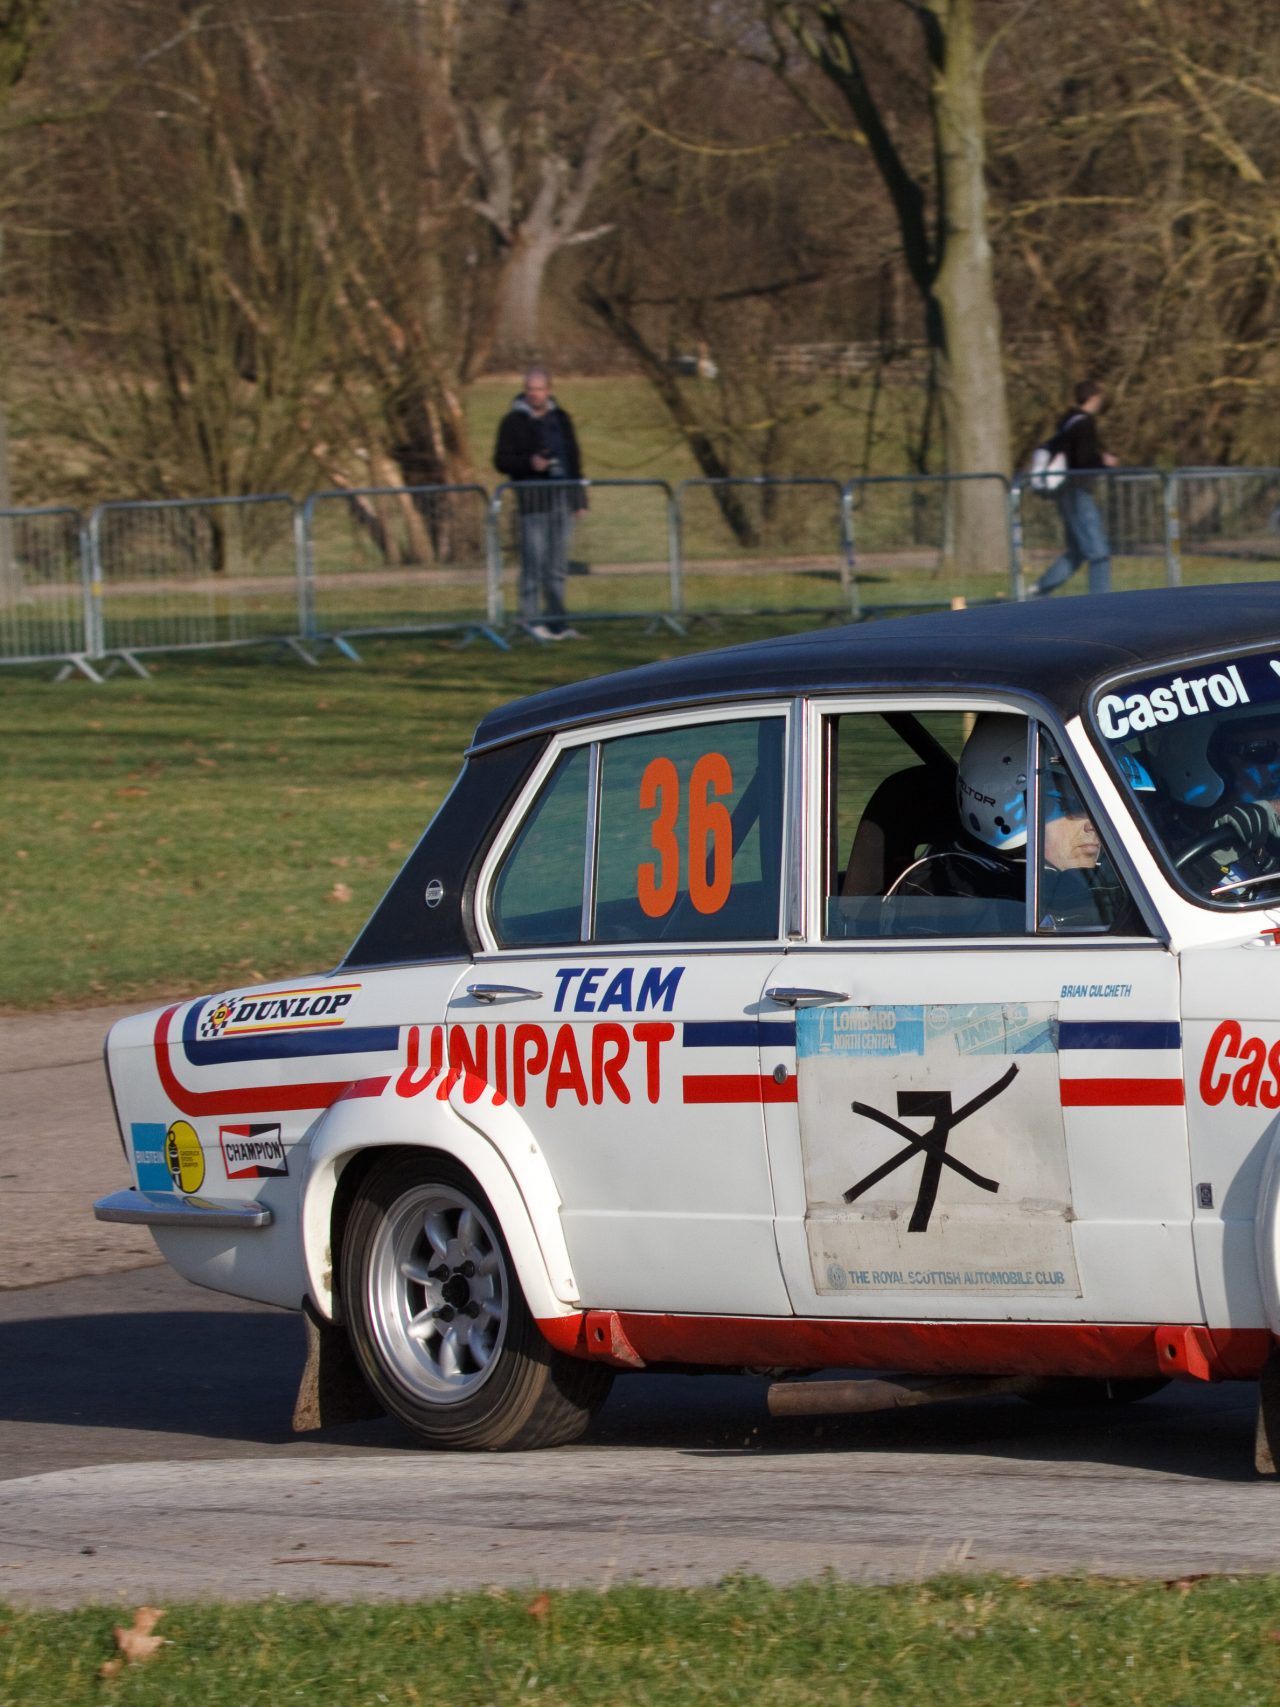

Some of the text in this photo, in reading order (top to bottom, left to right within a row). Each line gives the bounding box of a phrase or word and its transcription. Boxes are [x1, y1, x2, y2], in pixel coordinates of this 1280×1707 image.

[1096, 665, 1250, 739] Castrol
[637, 752, 734, 918] 36
[553, 966, 686, 1012] TEAM
[1060, 984, 1132, 998] BRIAN CULCHETH
[232, 993, 353, 1023] DUNLOP
[833, 1009, 897, 1032] LOMBARD
[833, 1033, 897, 1050] NORTH CENTRAL
[395, 1022, 675, 1108] UNIPART
[225, 1141, 282, 1161] CHAMPION
[848, 1270, 1065, 1286] THE ROYAL SCOTTISH AUTOMOBILE CLUB
